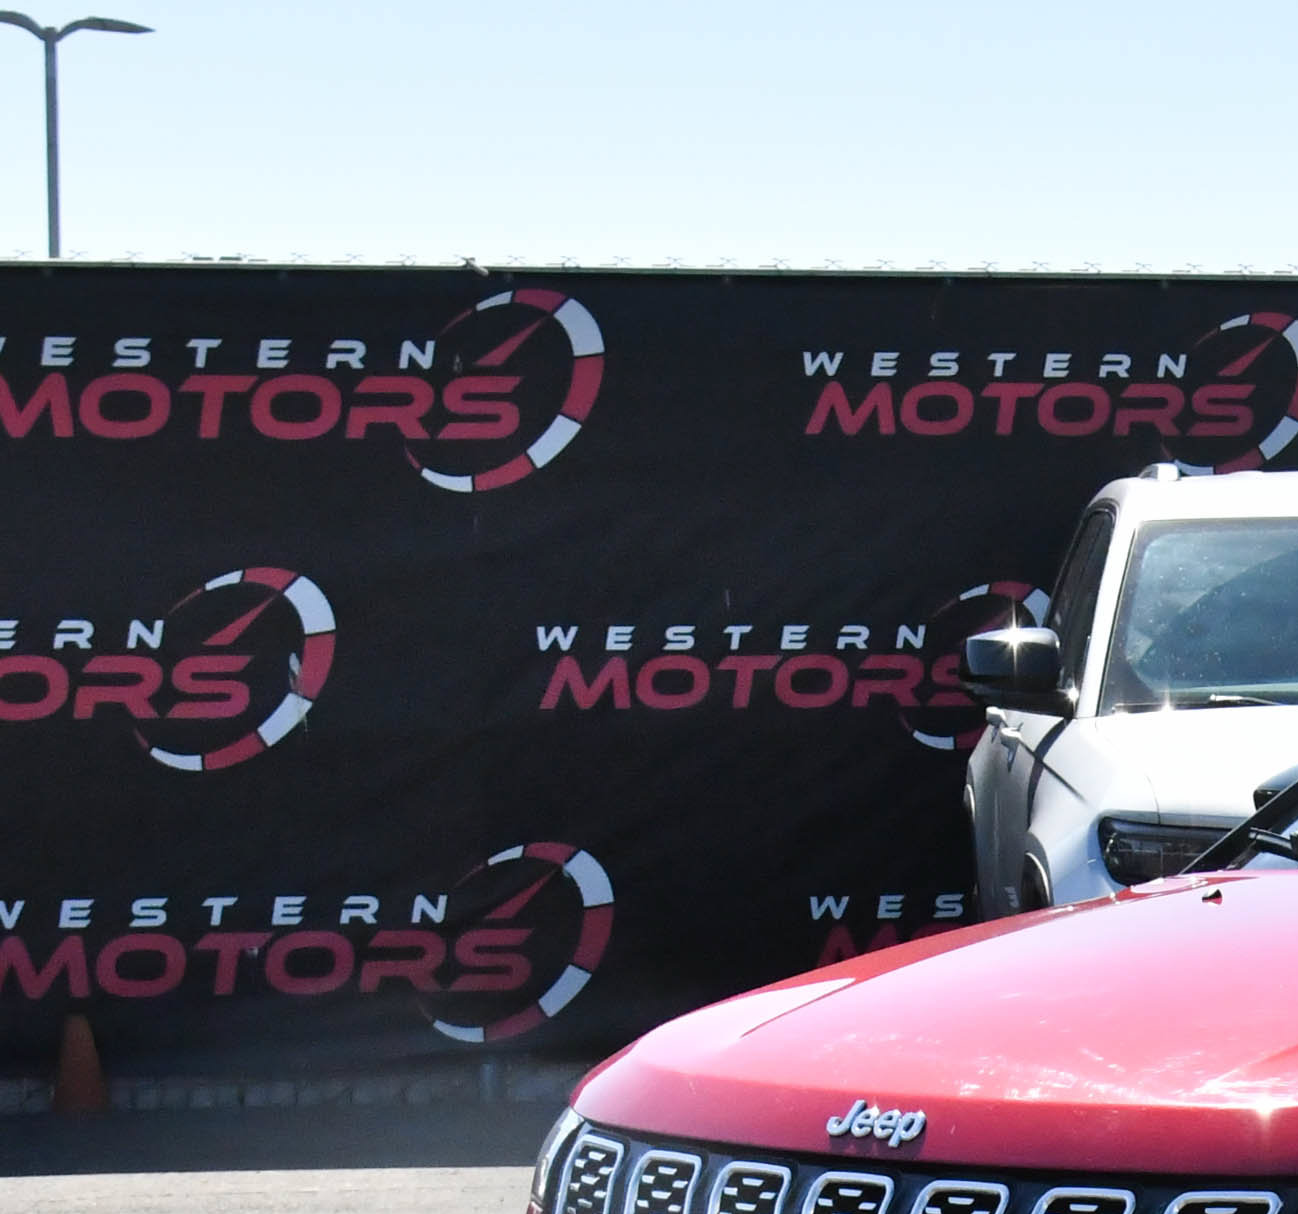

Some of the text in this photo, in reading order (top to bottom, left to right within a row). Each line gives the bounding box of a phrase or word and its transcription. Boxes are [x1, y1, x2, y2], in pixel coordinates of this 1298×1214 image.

[0, 336, 436, 371] ESTERN
[803, 350, 1187, 378] WESTERN
[804, 380, 1256, 437] MOTORS
[536, 625, 926, 652] WESTERN
[0, 929, 534, 999] MOTORS
[826, 1099, 927, 1148] Jeep
